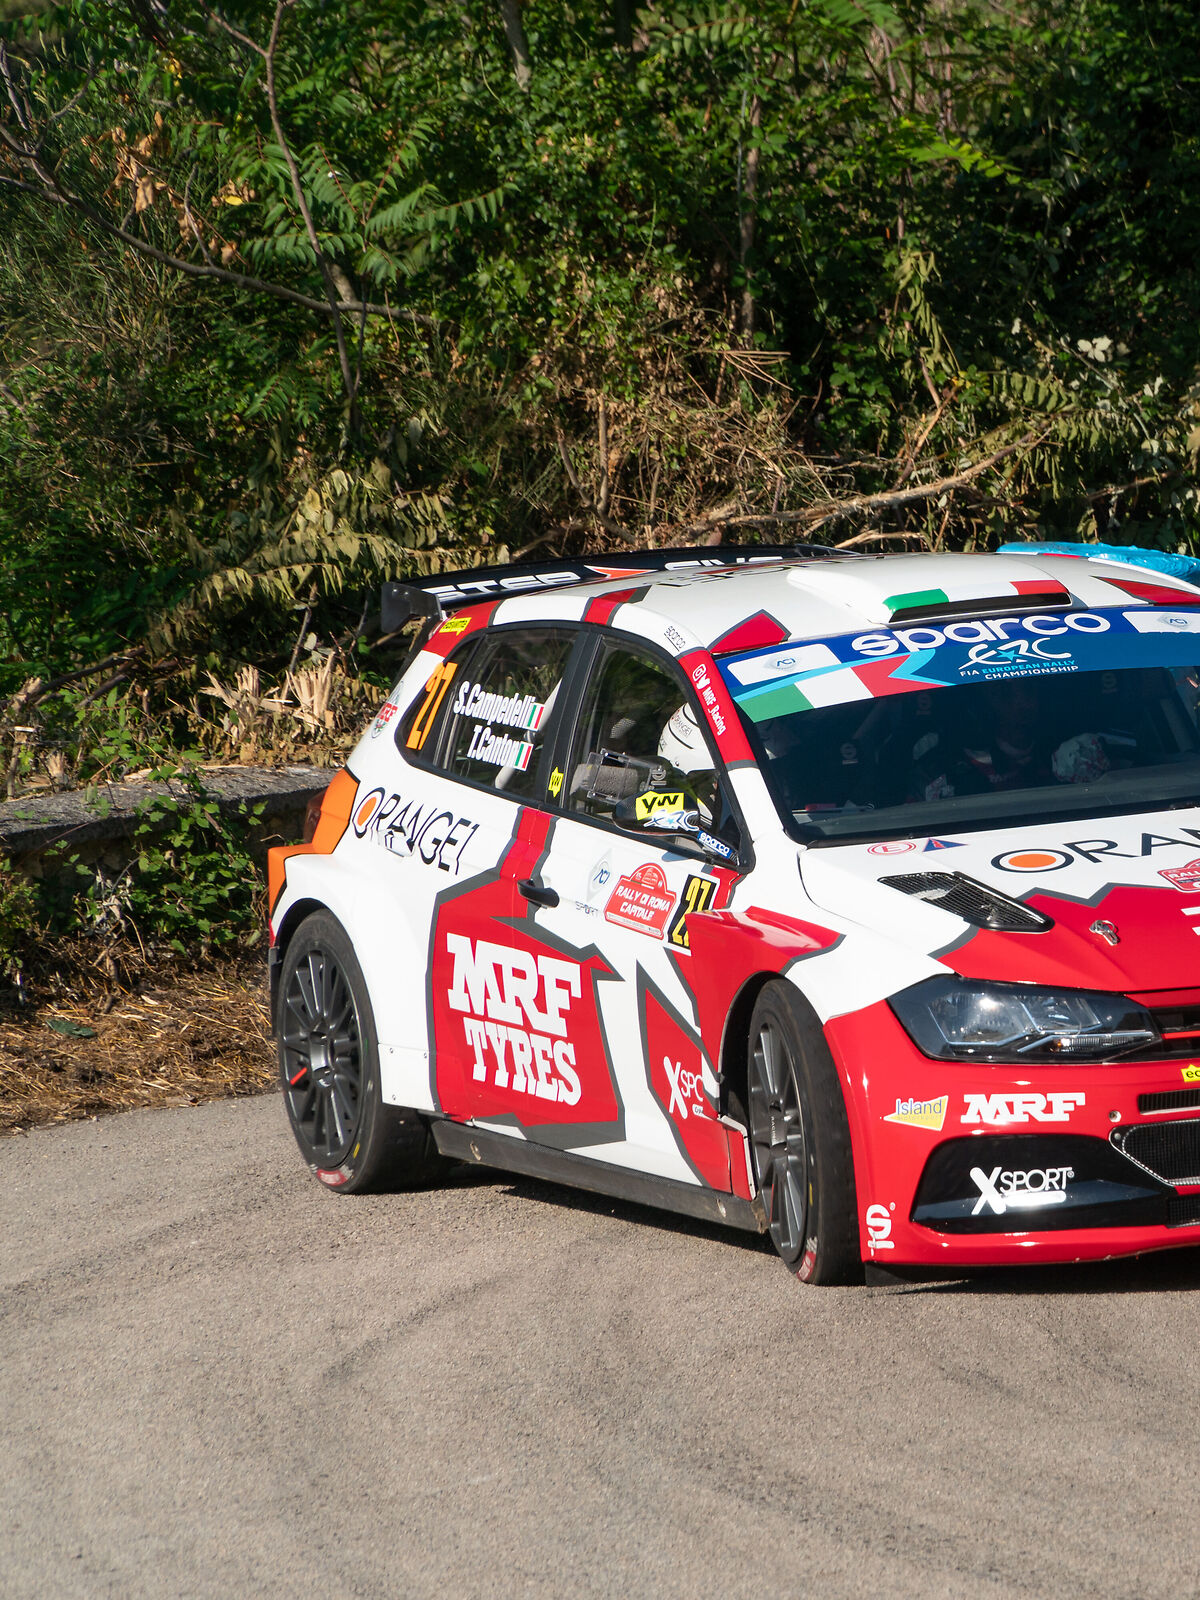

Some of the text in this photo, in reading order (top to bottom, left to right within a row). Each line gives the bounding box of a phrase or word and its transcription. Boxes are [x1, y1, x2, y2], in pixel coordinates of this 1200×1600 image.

[852, 612, 1111, 656] sparco
[960, 660, 1076, 677] FIA EUROPEAN RALLY
[984, 665, 1079, 680] CHAMPIONSHIP
[406, 662, 458, 750] 27
[352, 786, 480, 875] ORANGE1
[615, 886, 642, 901] RALLY
[646, 894, 670, 912] ROMA
[620, 902, 655, 921] CAPITALE
[446, 932, 582, 1037] MRF
[463, 1016, 582, 1106] TYRES
[897, 1099, 942, 1115] Island
[960, 1092, 1086, 1124] MRF
